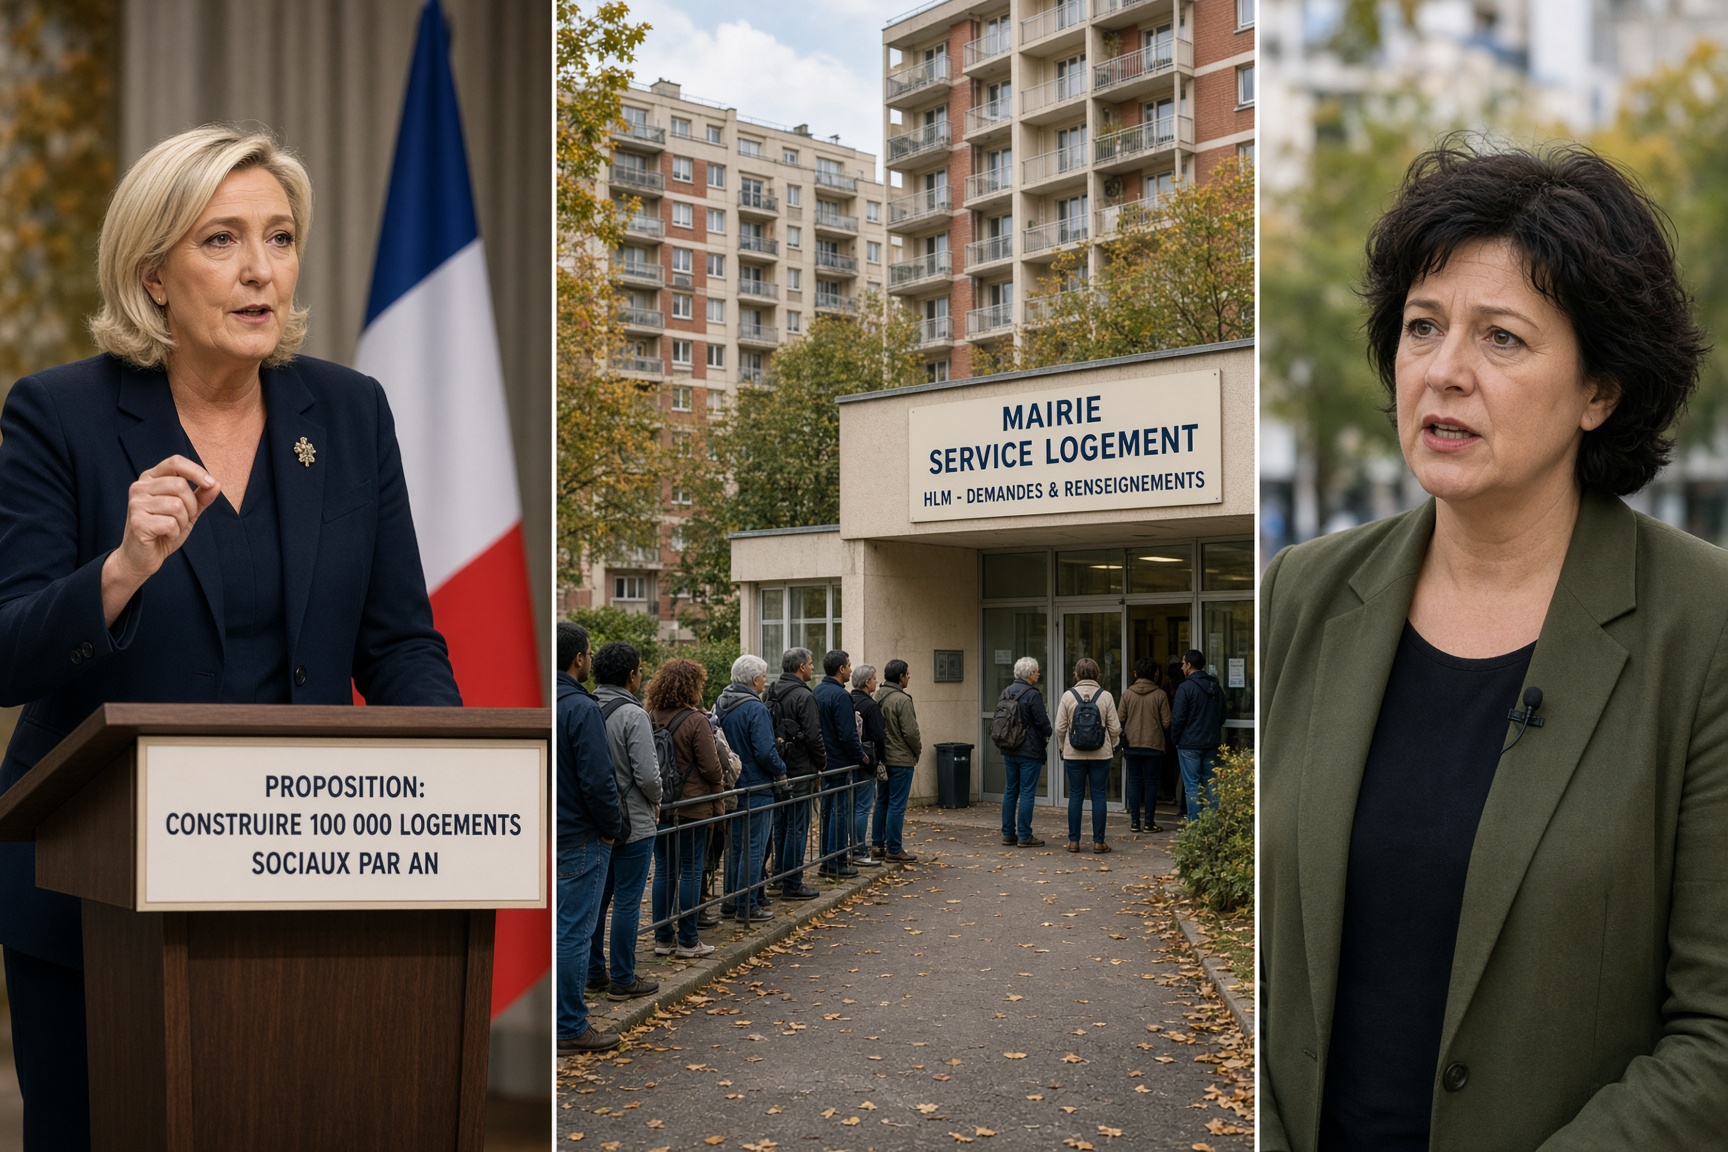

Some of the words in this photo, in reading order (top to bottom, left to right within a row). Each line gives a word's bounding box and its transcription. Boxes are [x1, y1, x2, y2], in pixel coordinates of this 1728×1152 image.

[1002, 395, 1102, 431] MAIRIE
[929, 440, 1033, 475] SERVICE
[1045, 423, 1199, 465] LOGEMENT
[923, 490, 952, 507] HLM
[966, 482, 1043, 504] DEMANDES
[1048, 481, 1059, 498] &
[1064, 470, 1205, 497] RENSEIGNEMENTS
[265, 775, 425, 798] PROPOSITION:
[165, 812, 302, 836] CONSTRUIRE
[310, 813, 346, 836] 100
[352, 813, 392, 836] 000
[400, 813, 522, 836] LOGEMENTS
[251, 851, 351, 875] SOCIAUX
[359, 851, 401, 875] PAR
[408, 851, 438, 875] AN
